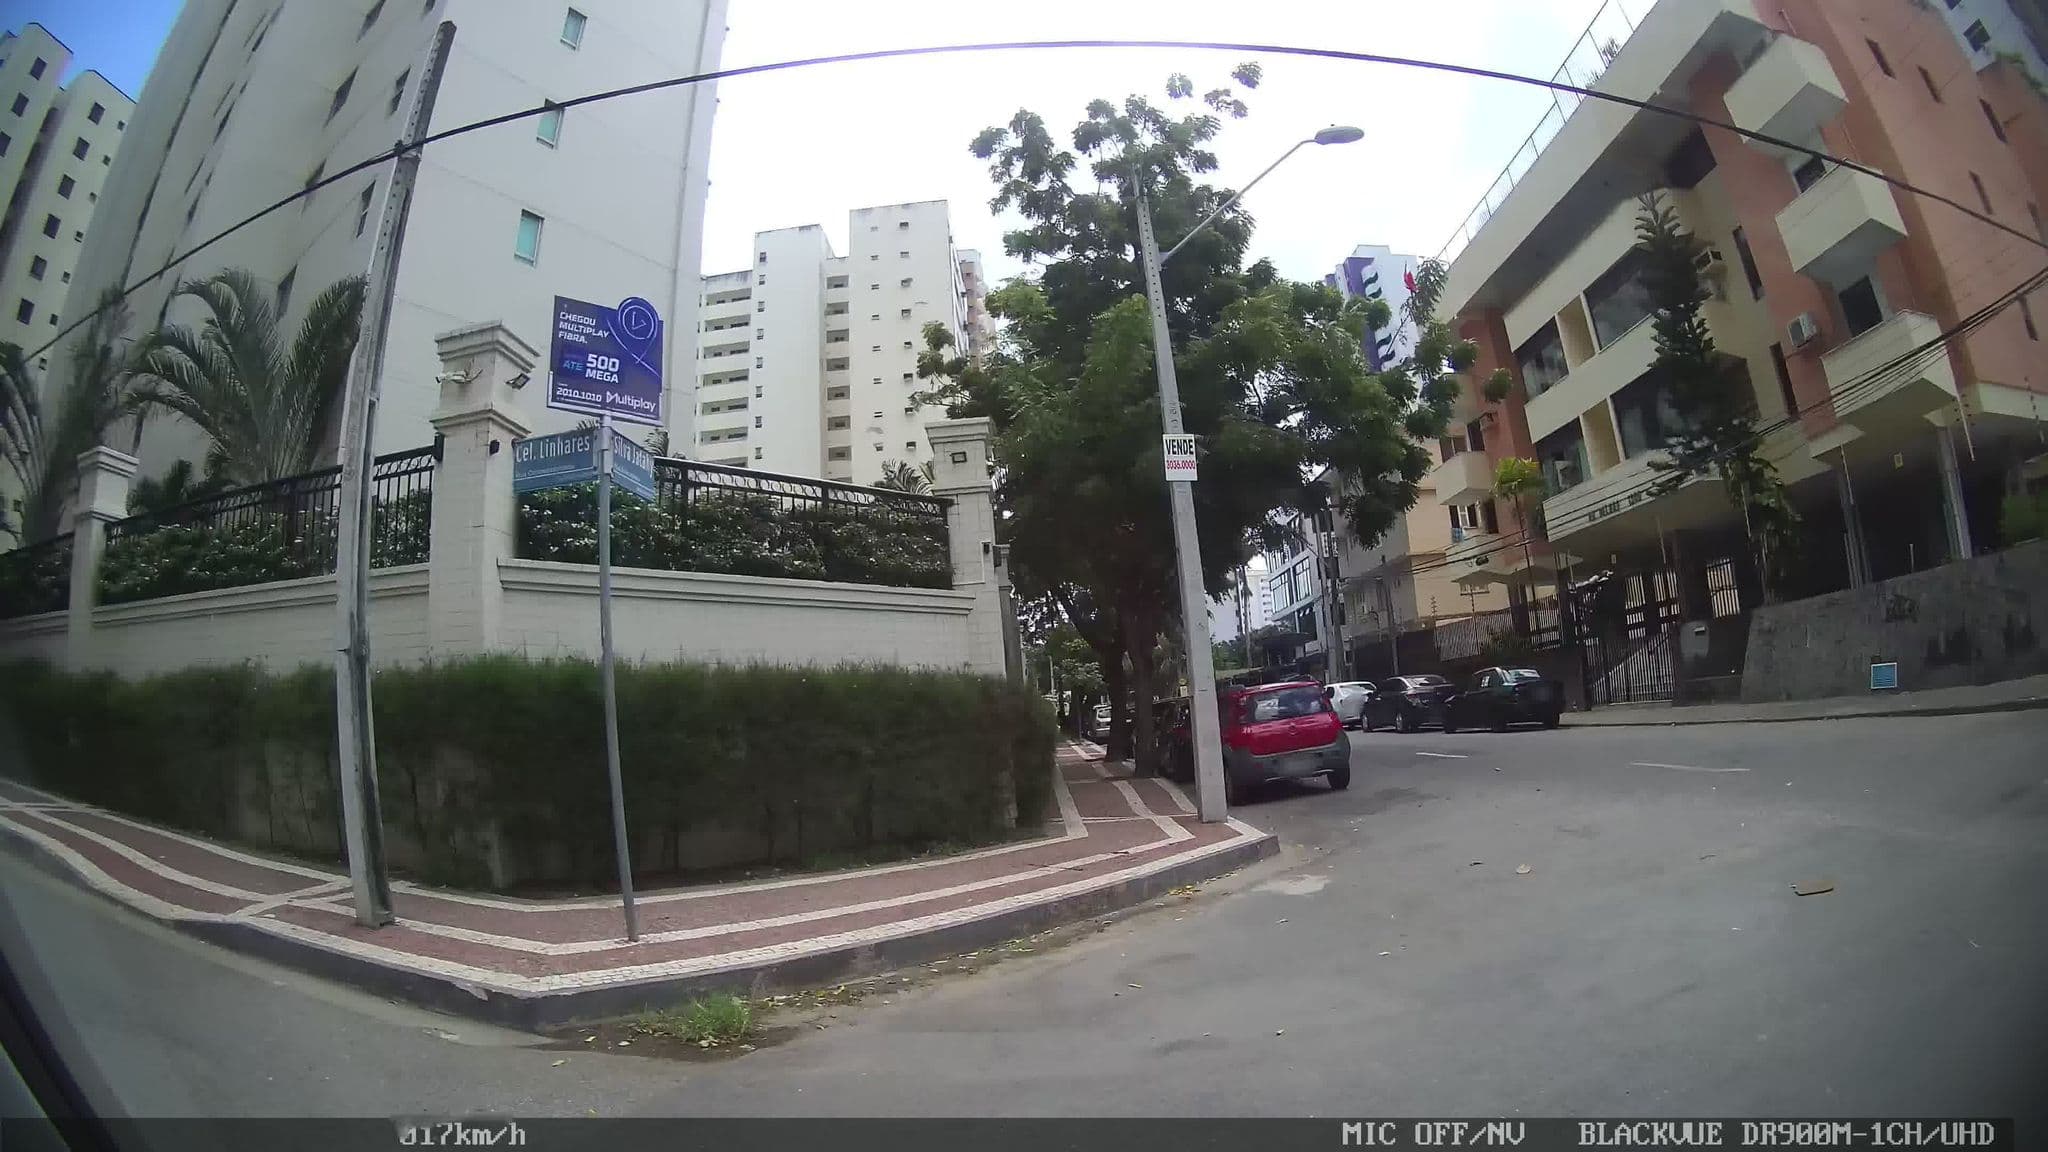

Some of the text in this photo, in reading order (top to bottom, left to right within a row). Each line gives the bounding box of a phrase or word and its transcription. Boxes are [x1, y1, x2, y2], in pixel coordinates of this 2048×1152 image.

[559, 311, 596, 326] CHEGOU
[558, 331, 588, 344] FIBRA.
[559, 321, 609, 338] MULTIPLAY
[586, 353, 620, 372] 500
[585, 369, 619, 383] MEGA
[556, 387, 602, 402] 2010.1010
[606, 390, 656, 412] Multiplay
[515, 435, 590, 463] Cel. Linhares
[614, 436, 631, 462] Silva
[1165, 439, 1194, 455] VENDE
